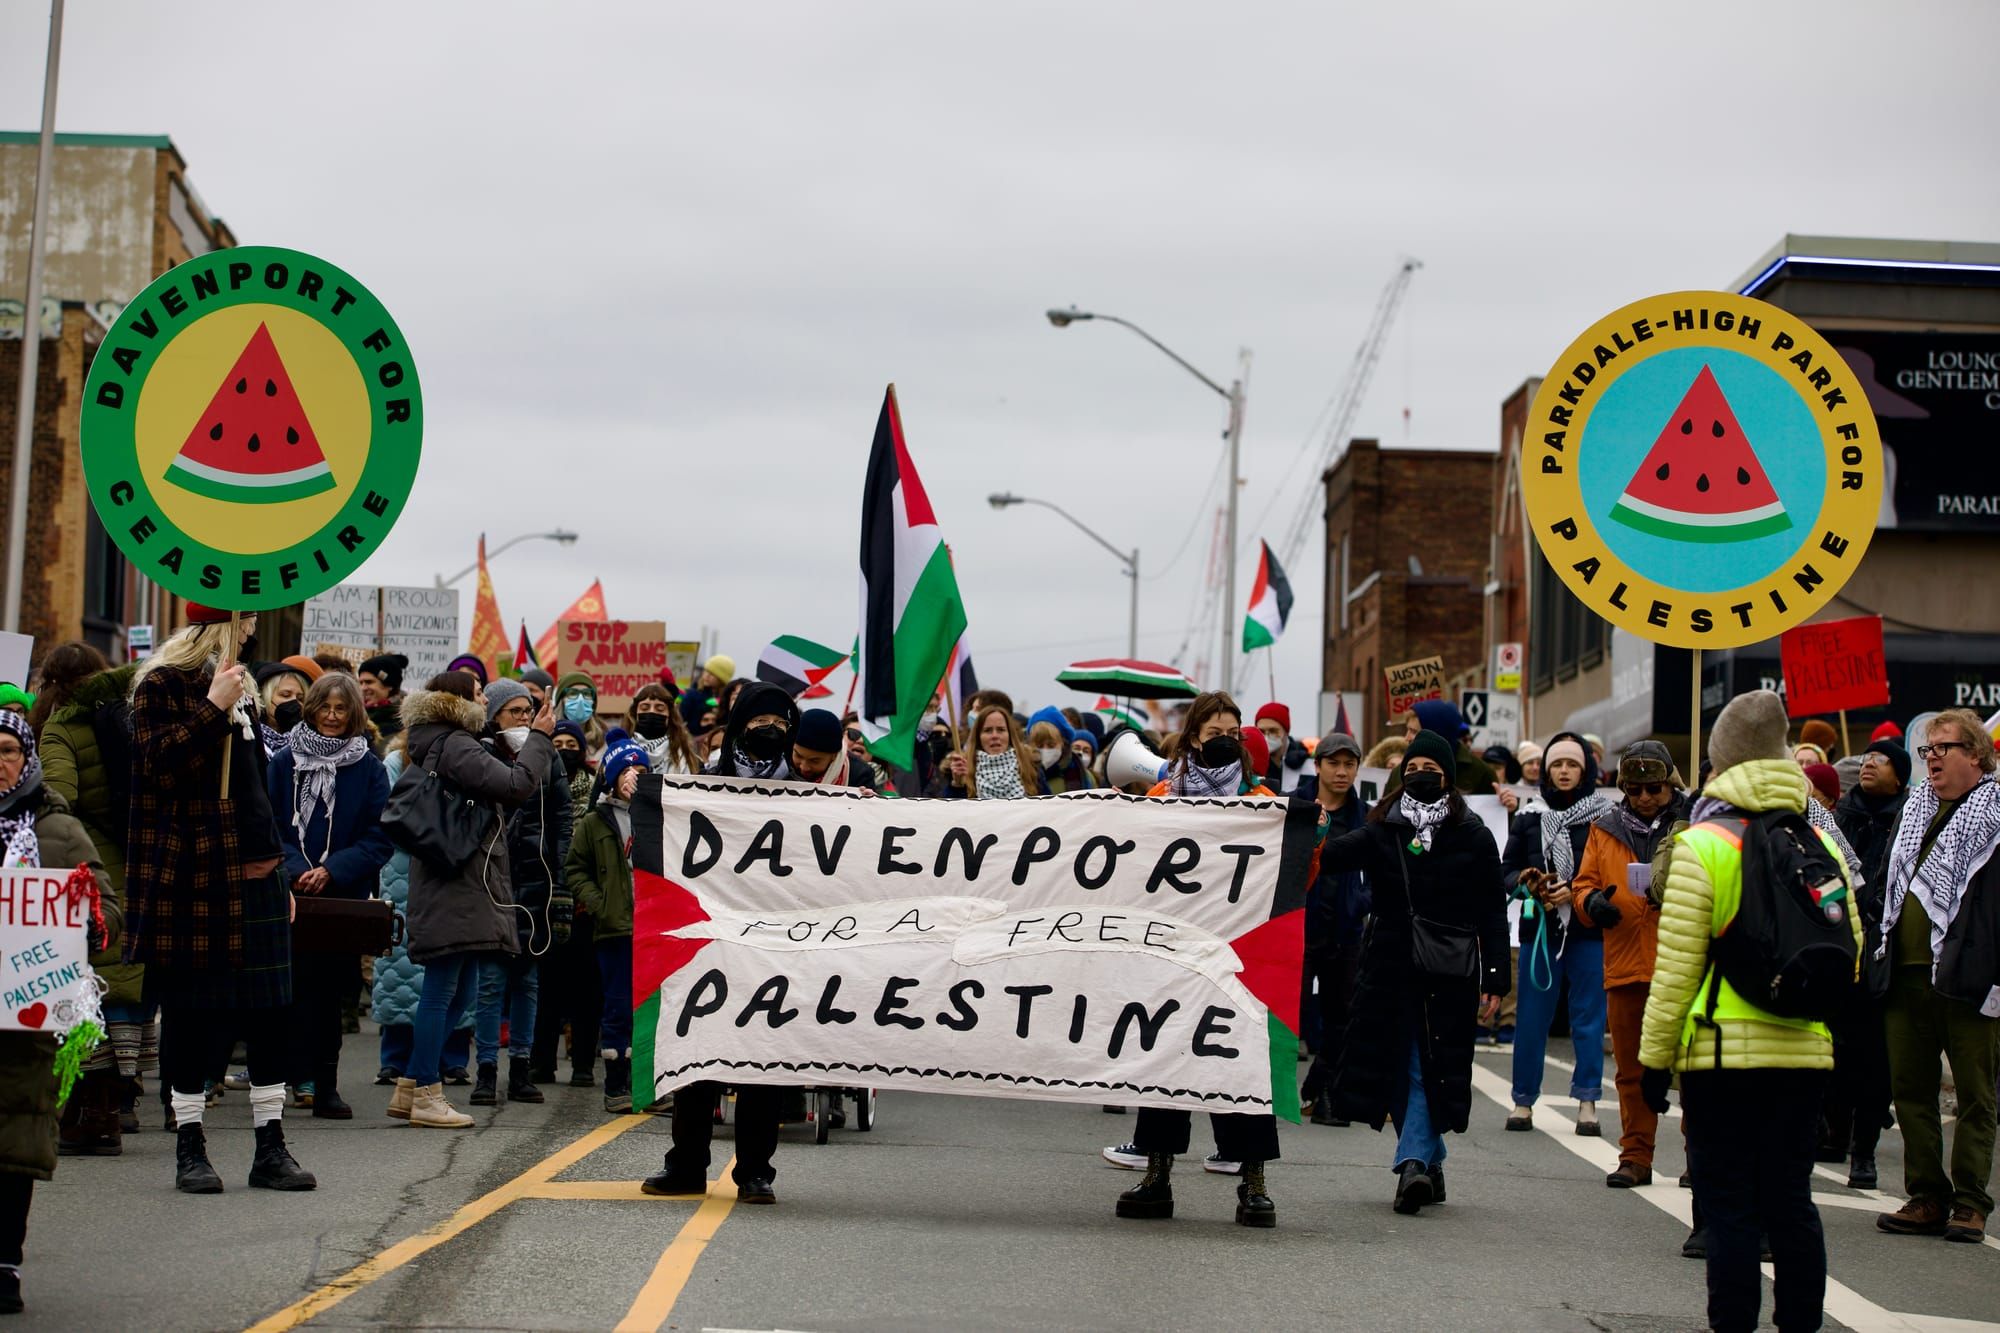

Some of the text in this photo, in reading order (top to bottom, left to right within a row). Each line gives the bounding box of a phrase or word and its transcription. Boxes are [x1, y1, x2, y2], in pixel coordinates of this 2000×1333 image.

[96, 262, 411, 425] DAVENPORT FOR
[1542, 309, 1864, 491] PARKDALE-HIGH PARK FOR
[110, 481, 389, 594] CEASEFIRE
[332, 586, 361, 602] AM
[388, 589, 451, 609] PROUD
[1551, 518, 1848, 633] PALESTINE
[305, 608, 459, 632] JEWISH ANTIZIONIST
[566, 621, 629, 642] STOP
[575, 641, 666, 667] ARMING
[1801, 631, 1843, 657] FREE
[578, 669, 663, 698] ENOCID
[1391, 676, 1441, 697] GROW A
[1789, 652, 1884, 699] PALESTINE
[681, 810, 1265, 904] DAVENPORT
[741, 908, 1177, 952] FOR A FREE
[11, 940, 59, 973] FREE
[4, 961, 84, 1010] PALESTINE
[676, 968, 1240, 1059] PALESTINE
